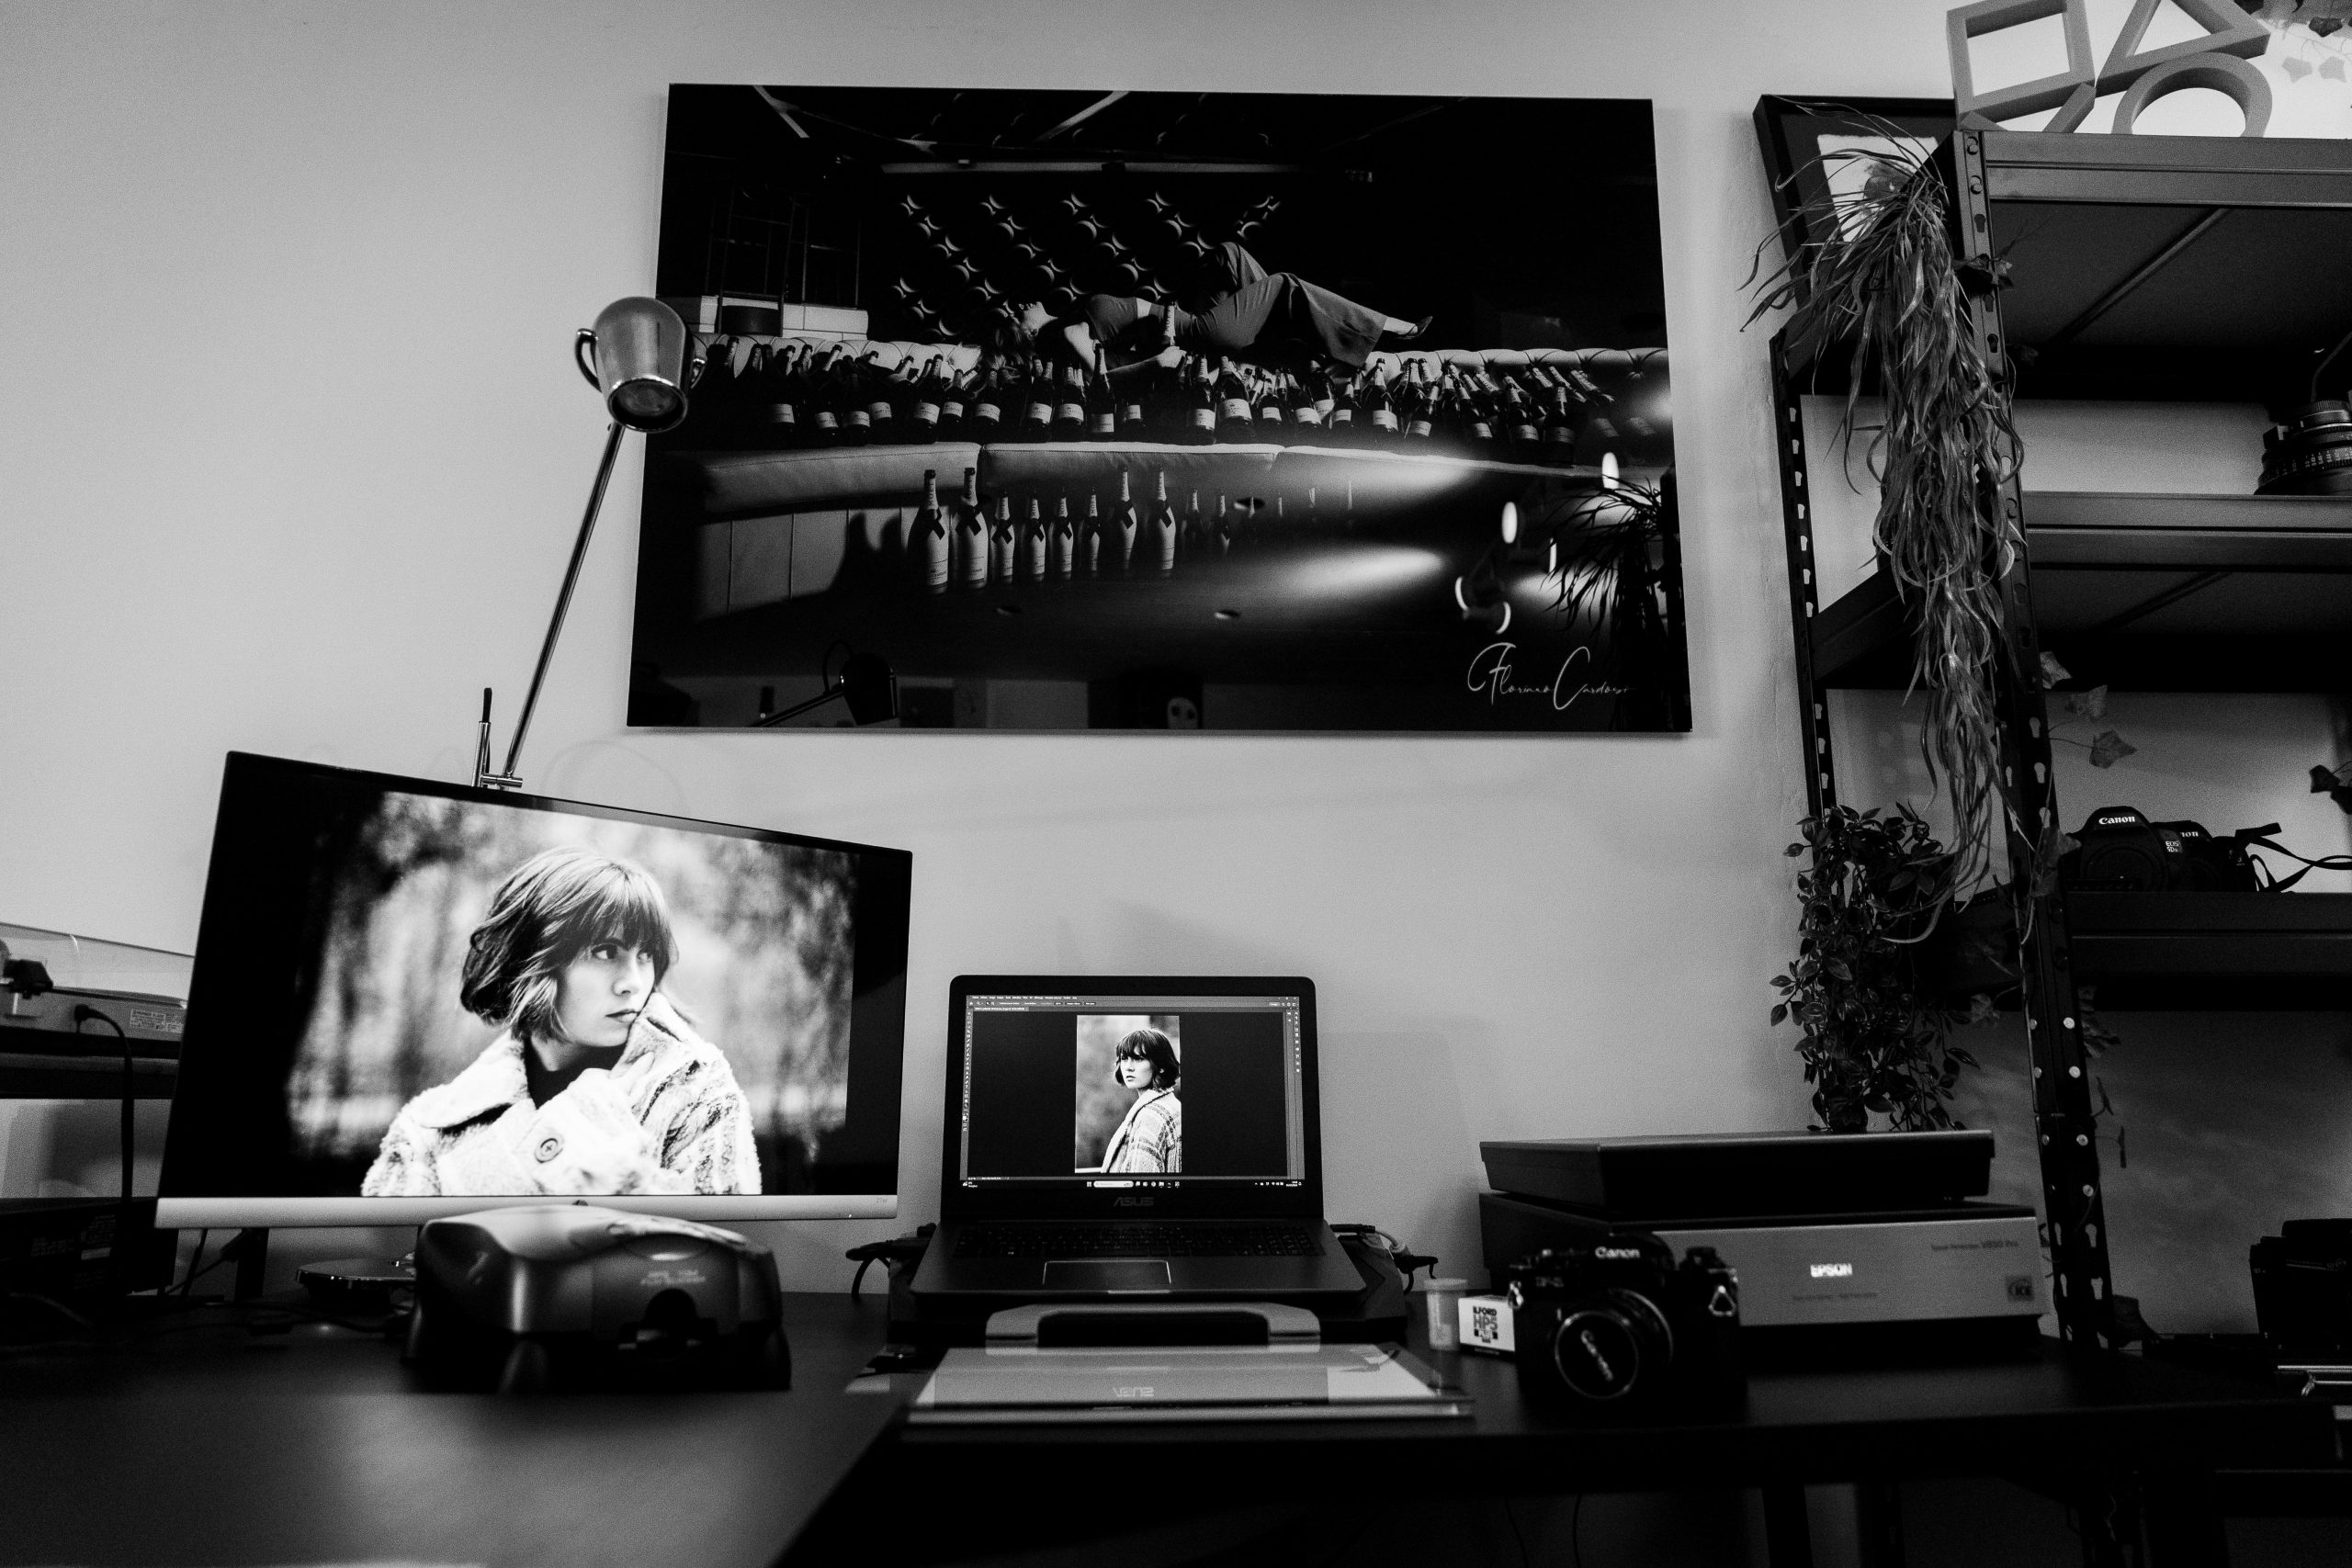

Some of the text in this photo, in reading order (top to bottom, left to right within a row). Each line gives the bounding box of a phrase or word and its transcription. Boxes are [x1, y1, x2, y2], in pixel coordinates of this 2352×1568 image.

[2098, 816, 2136, 825] Canon
[1114, 1197, 1155, 1207] ASUS
[1594, 1246, 1642, 1260] Canon
[1810, 1262, 1853, 1278] EPSON
